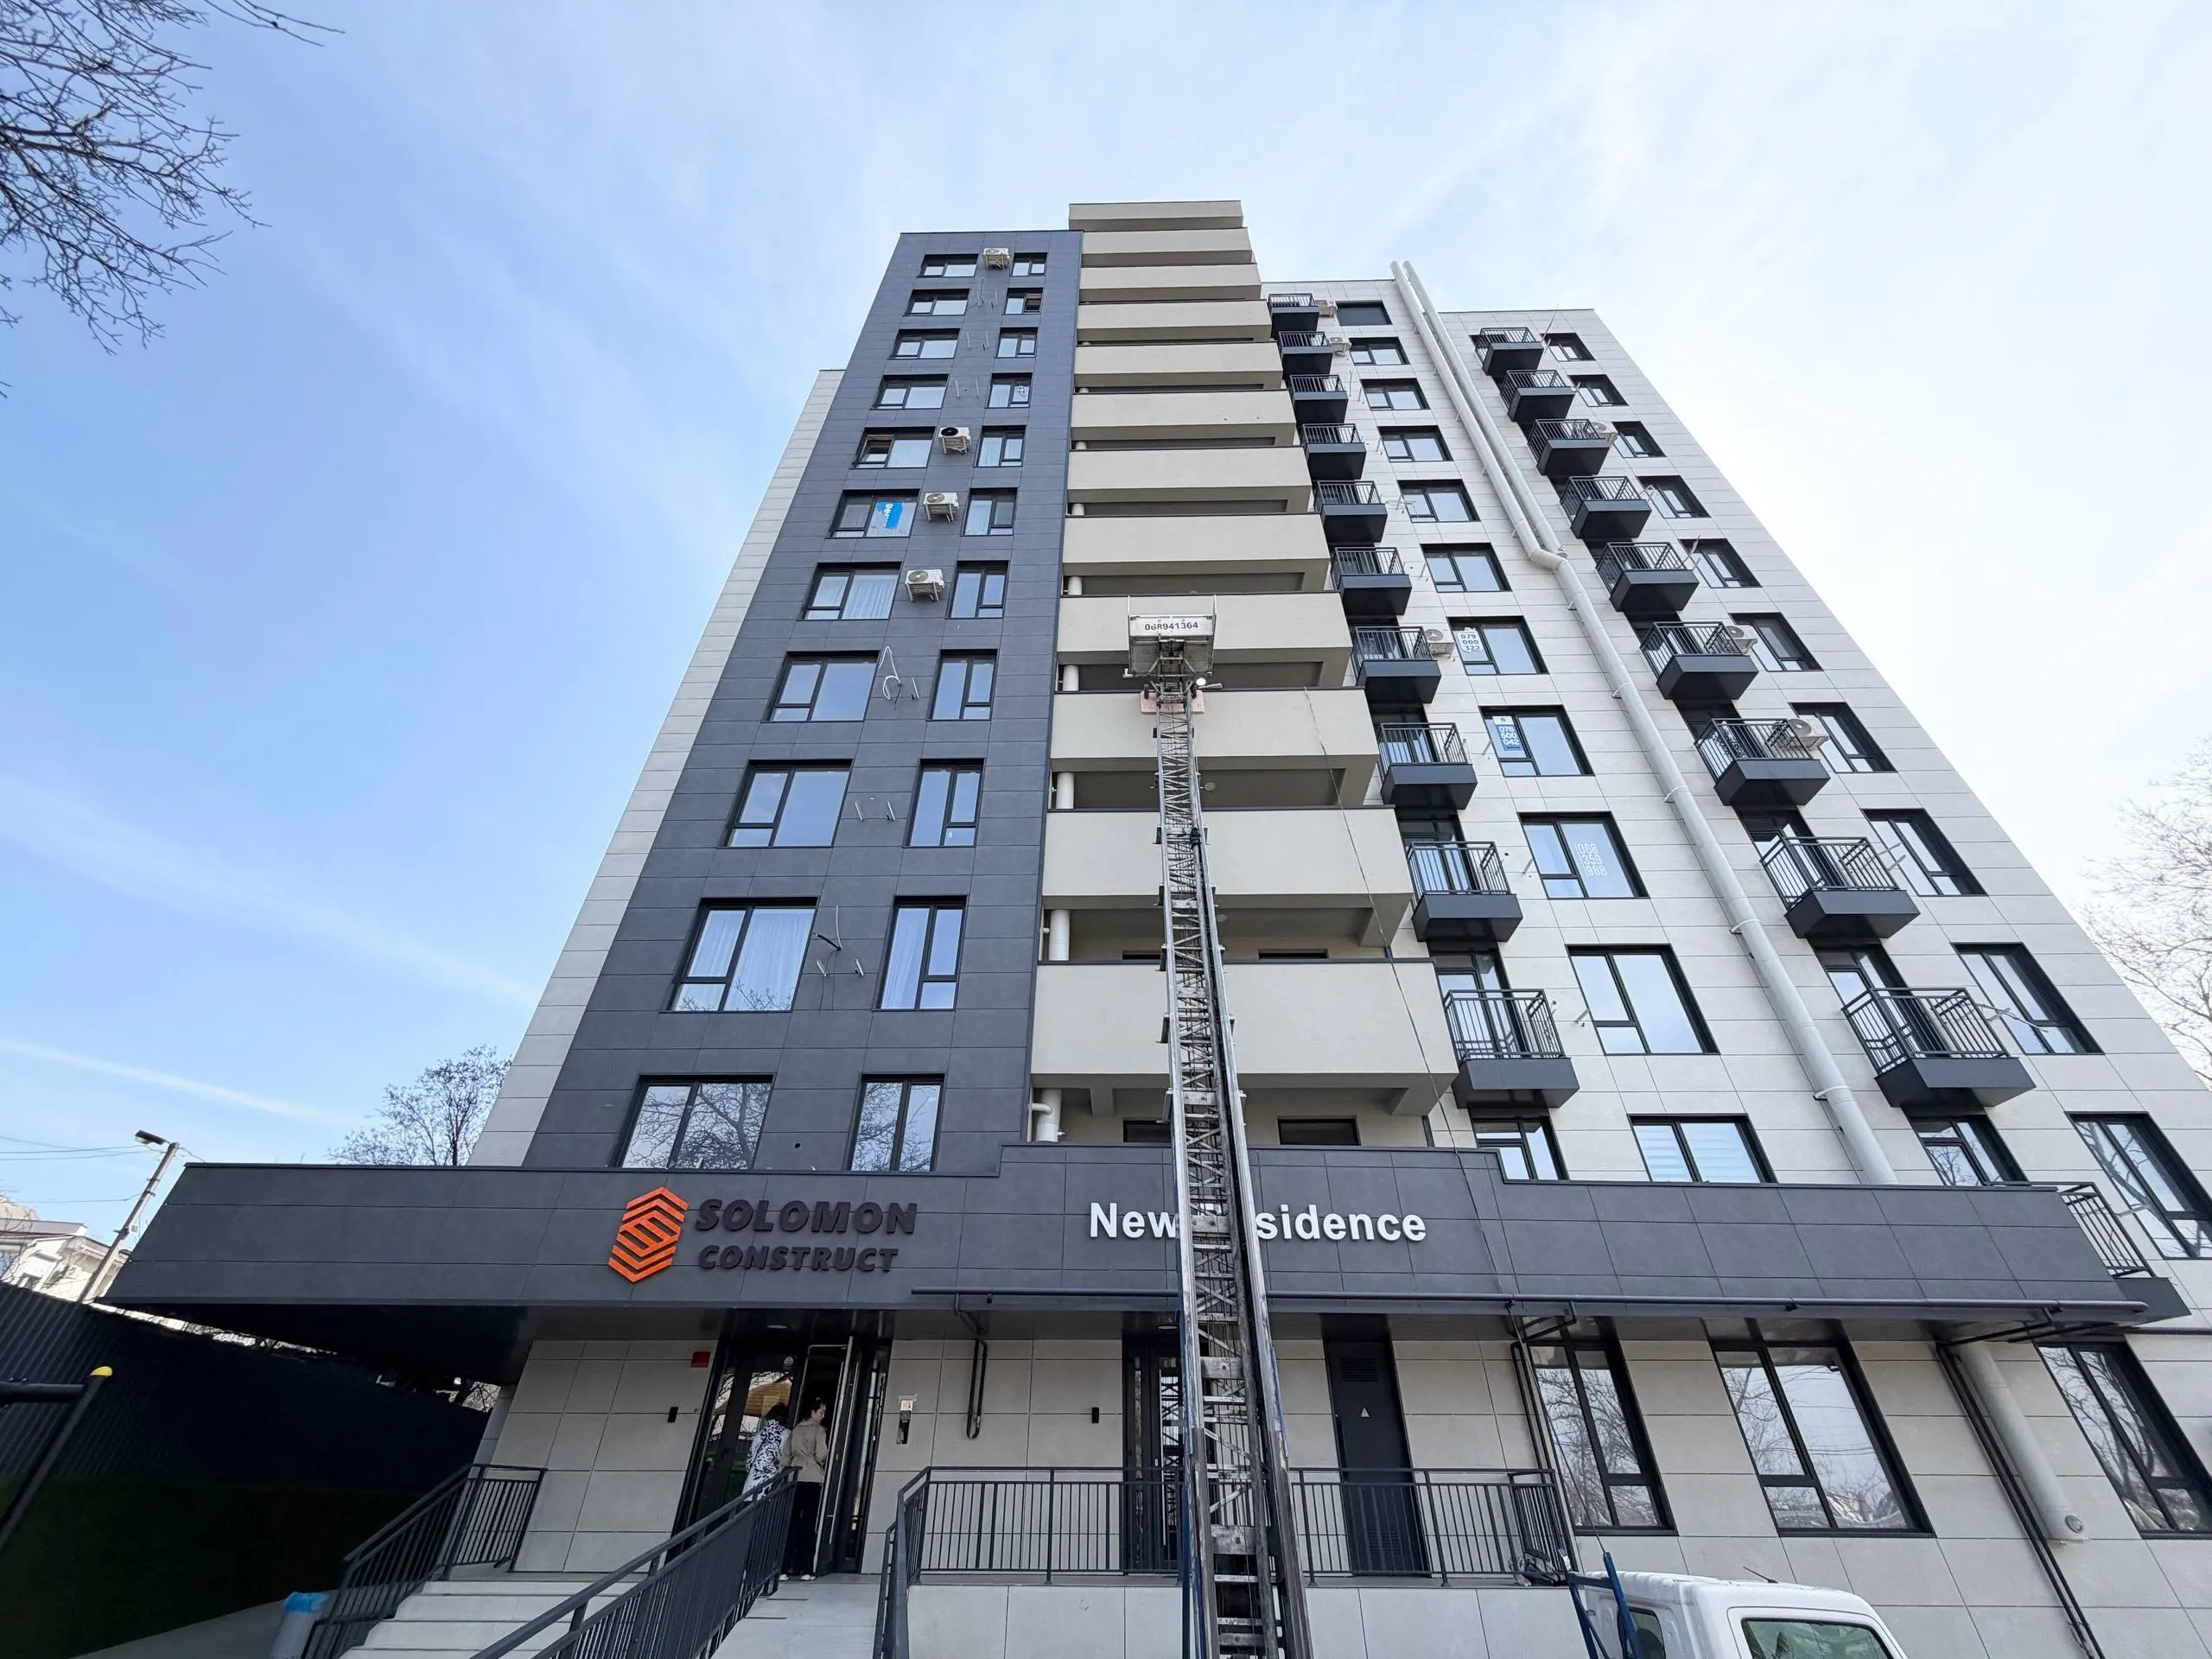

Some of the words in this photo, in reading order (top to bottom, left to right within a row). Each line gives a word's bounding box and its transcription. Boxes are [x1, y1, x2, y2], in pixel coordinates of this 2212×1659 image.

[695, 1198, 918, 1234] SOLOMON
[1090, 1202, 1176, 1238] New
[1198, 1204, 1427, 1242] sidence
[697, 1244, 899, 1273] CONSTRUCT
